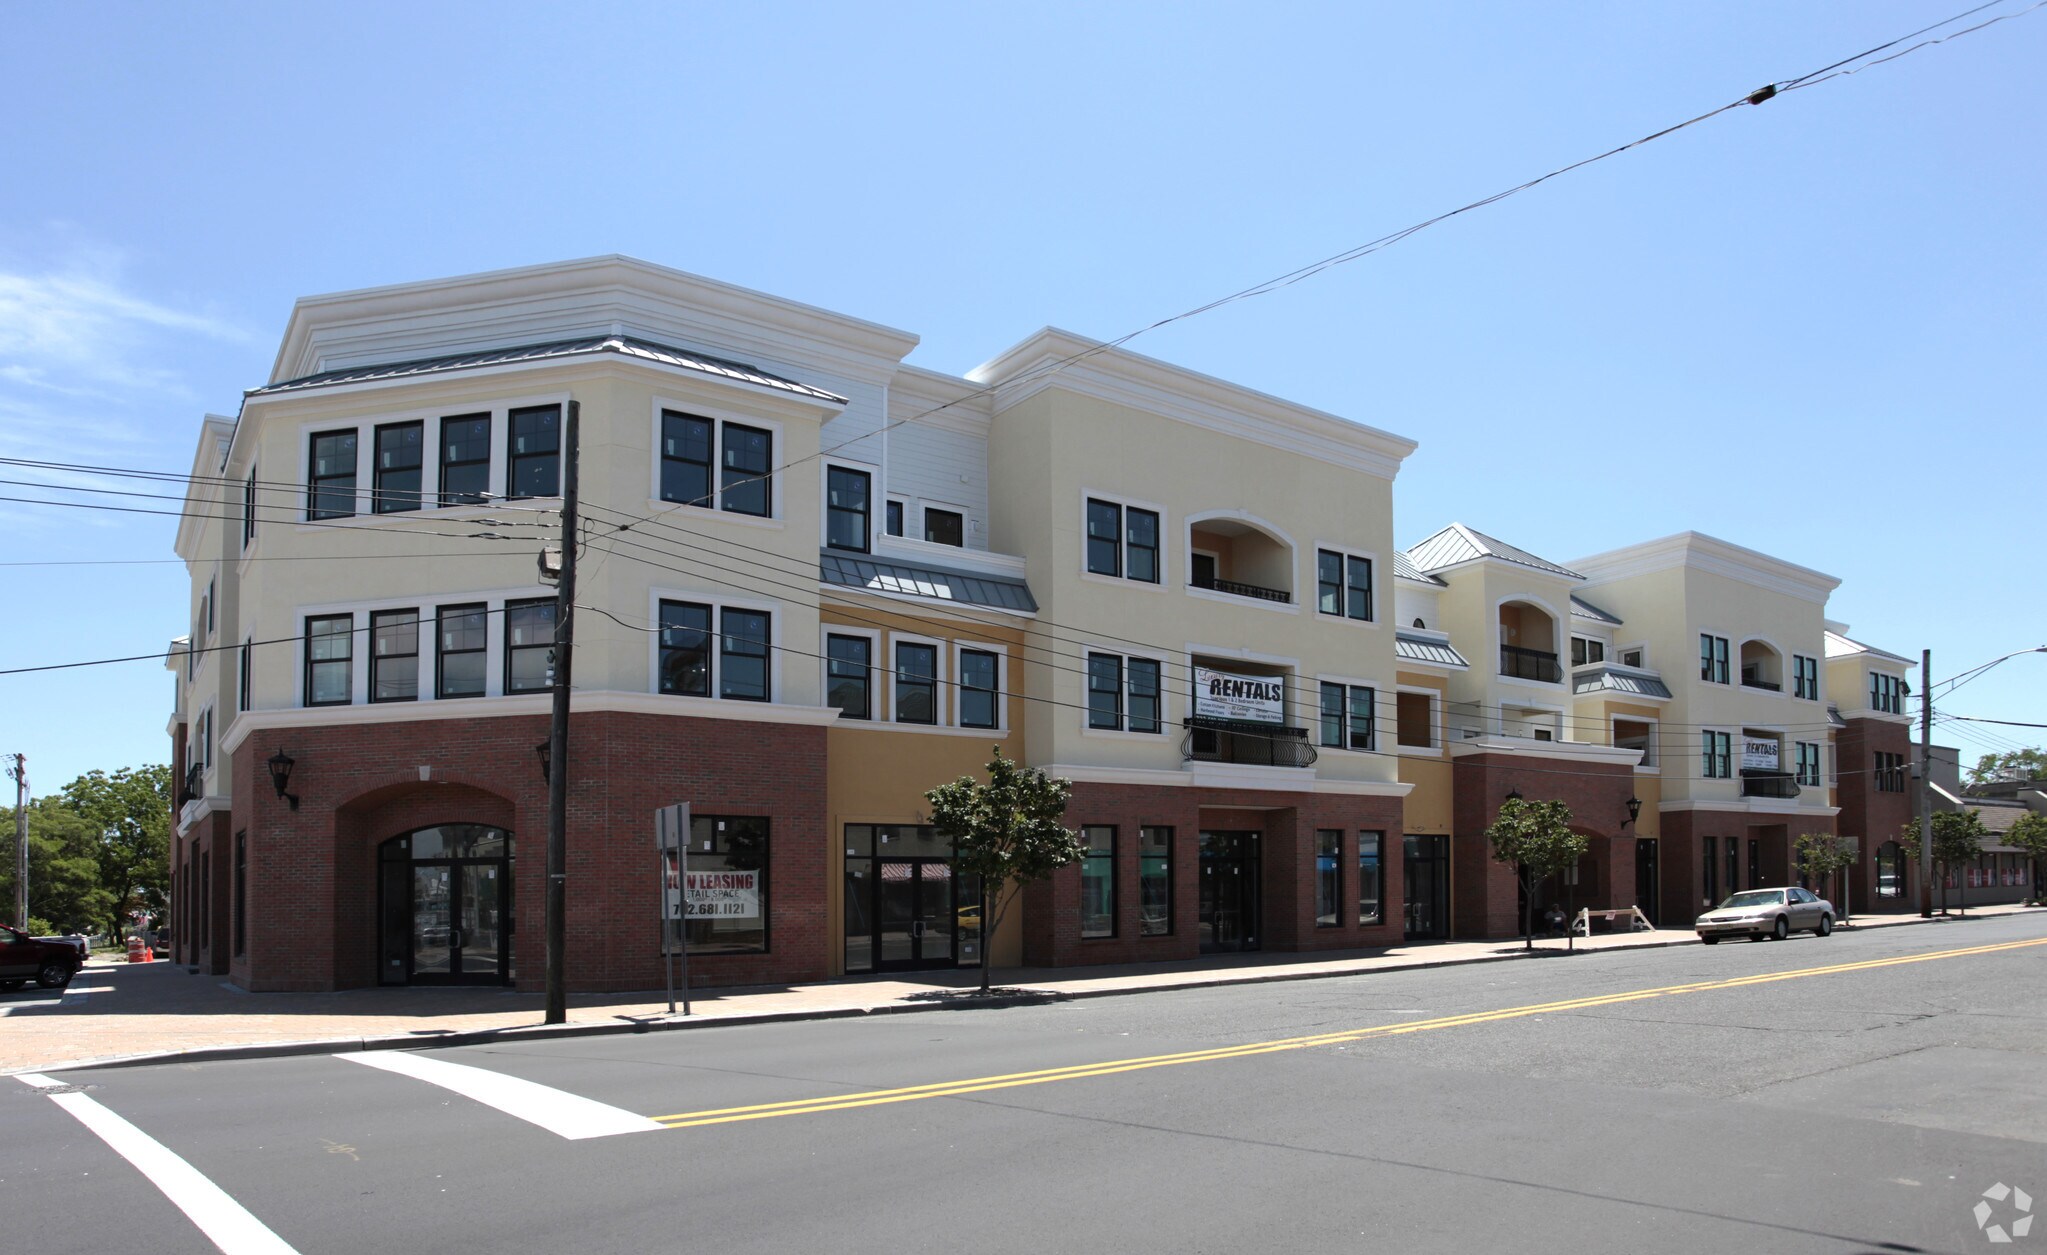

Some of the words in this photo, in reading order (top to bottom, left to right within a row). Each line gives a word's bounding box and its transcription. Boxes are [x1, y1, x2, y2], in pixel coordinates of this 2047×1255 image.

[1210, 679, 1281, 702] RENTALS
[1745, 742, 1777, 755] RENTALS
[700, 874, 753, 889] LEASING
[687, 890, 710, 898] TAIL
[712, 889, 739, 897] SPACE
[673, 903, 744, 915] 72.681.1121
